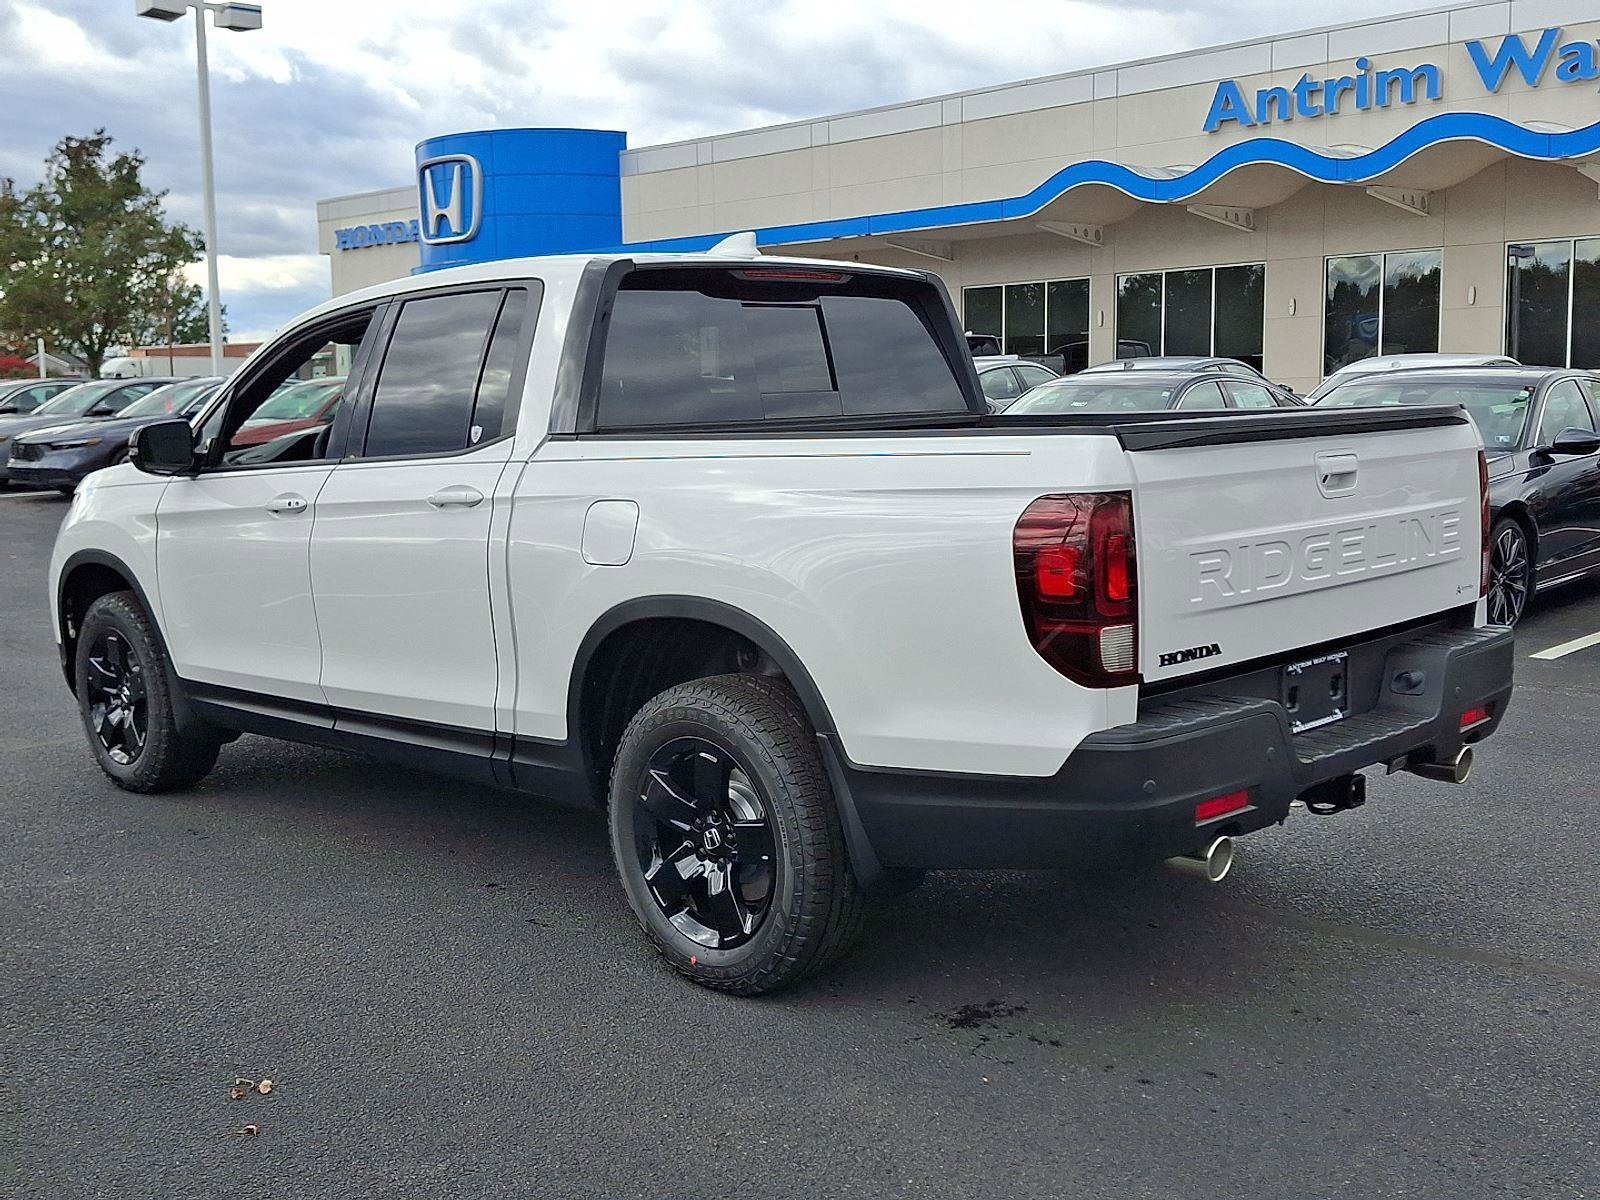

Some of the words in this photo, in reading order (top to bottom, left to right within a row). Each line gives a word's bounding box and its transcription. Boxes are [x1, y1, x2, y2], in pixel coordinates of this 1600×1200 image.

[1202, 57, 1443, 134] Antrim
[1464, 27, 1600, 96] Wa
[335, 219, 419, 251] HONDA
[1189, 511, 1461, 602] RIDGELINE
[1158, 643, 1222, 668] HONDA
